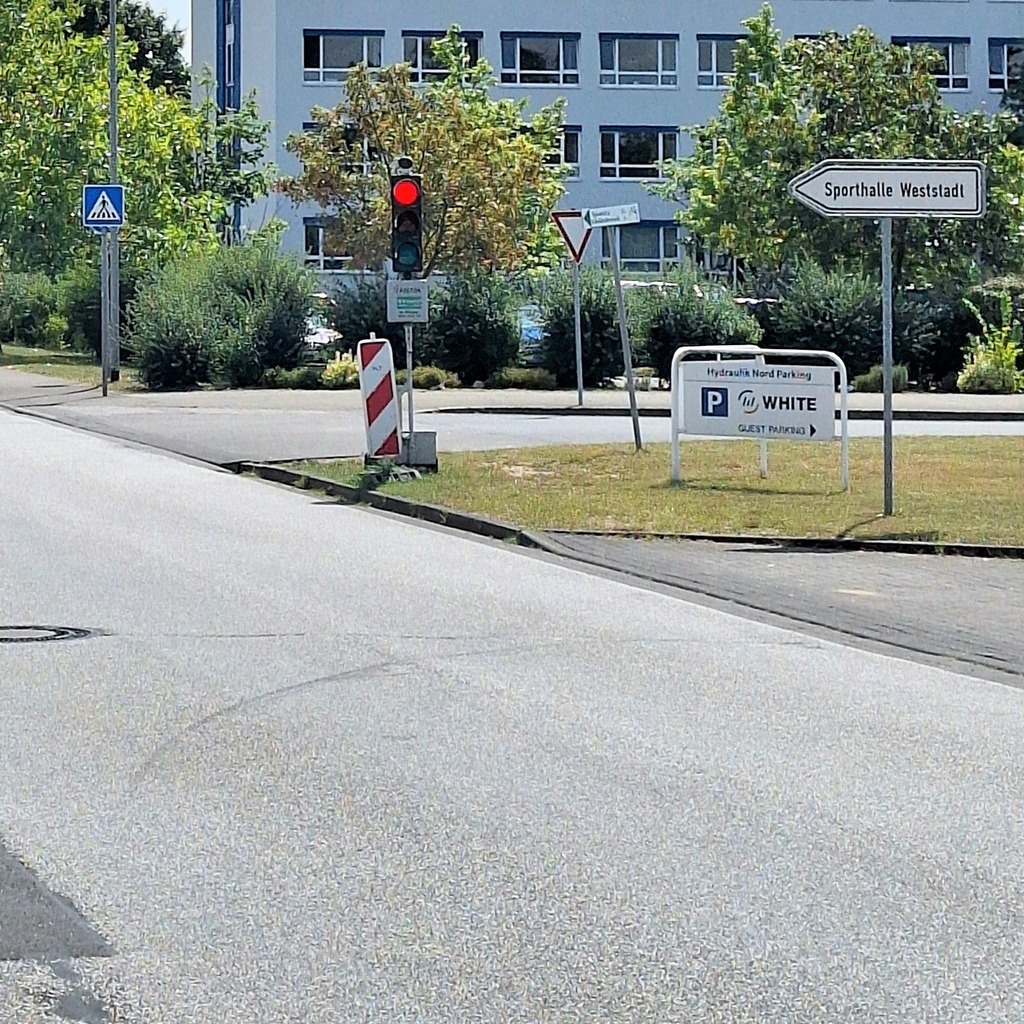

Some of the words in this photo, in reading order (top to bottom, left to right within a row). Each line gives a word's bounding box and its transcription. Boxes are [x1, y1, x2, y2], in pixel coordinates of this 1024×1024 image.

[825, 182, 893, 201] Sporthalle
[900, 182, 964, 198] Weststadt
[707, 367, 750, 378] Hydraulik
[752, 368, 774, 378] Nord
[777, 369, 812, 381] Parking
[707, 391, 723, 414] P
[762, 396, 817, 411] WHITE
[738, 424, 765, 434] GUEST
[768, 425, 806, 435] PARKING
